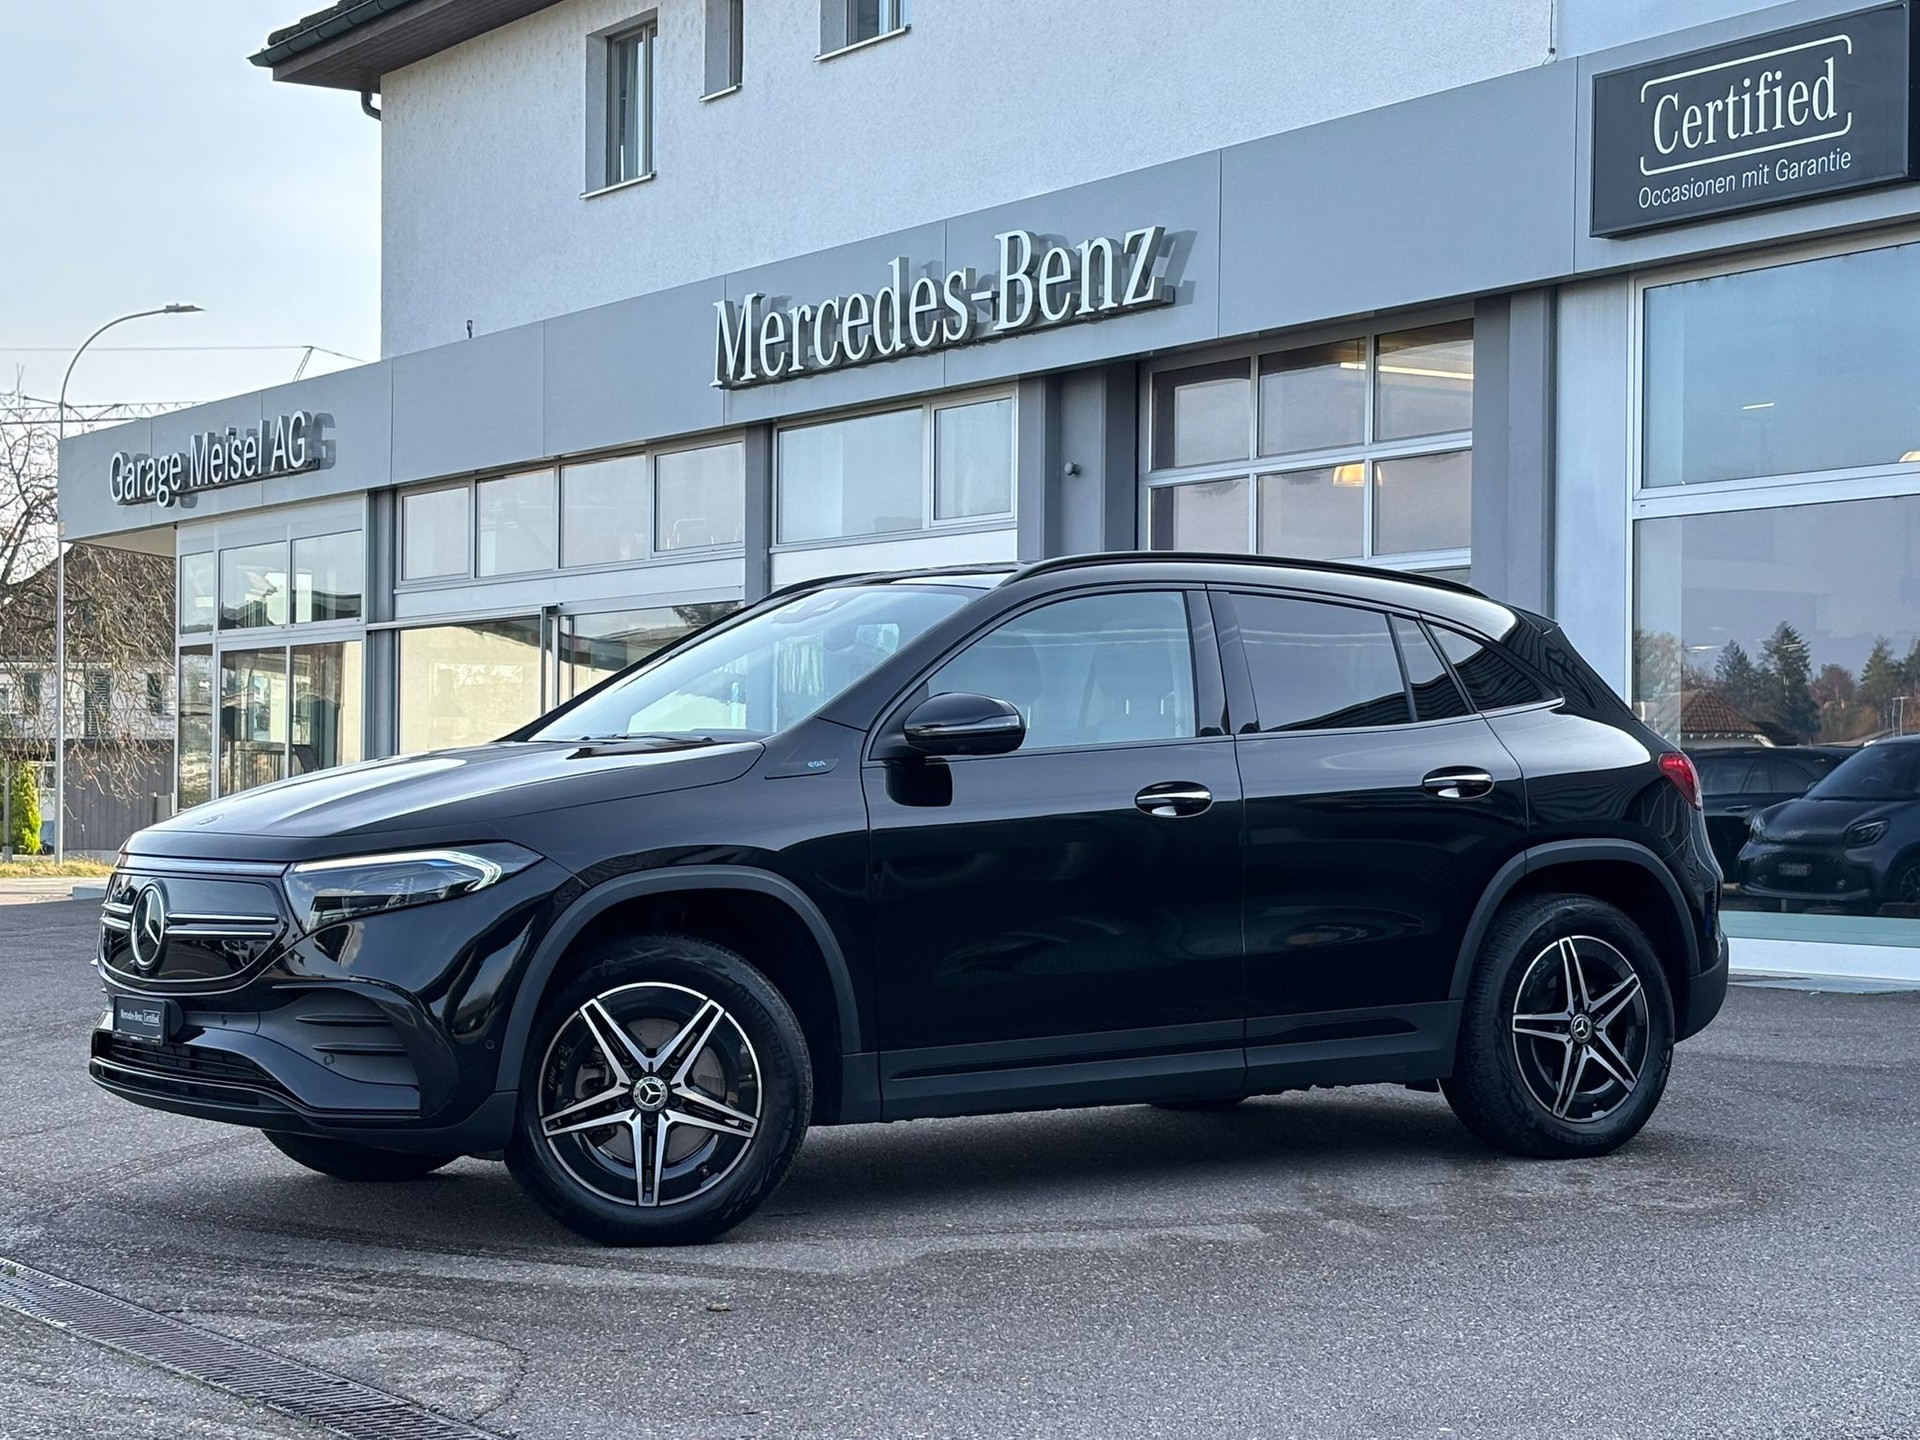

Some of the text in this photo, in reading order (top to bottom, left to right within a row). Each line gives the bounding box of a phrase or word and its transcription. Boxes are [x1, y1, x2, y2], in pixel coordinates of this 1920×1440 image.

[1653, 55, 1838, 155] Certified
[1637, 147, 1852, 210] Occasionen mit Garantie
[709, 225, 1167, 389] Mercedes-Benz
[109, 410, 308, 508] Garage Meisel AG
